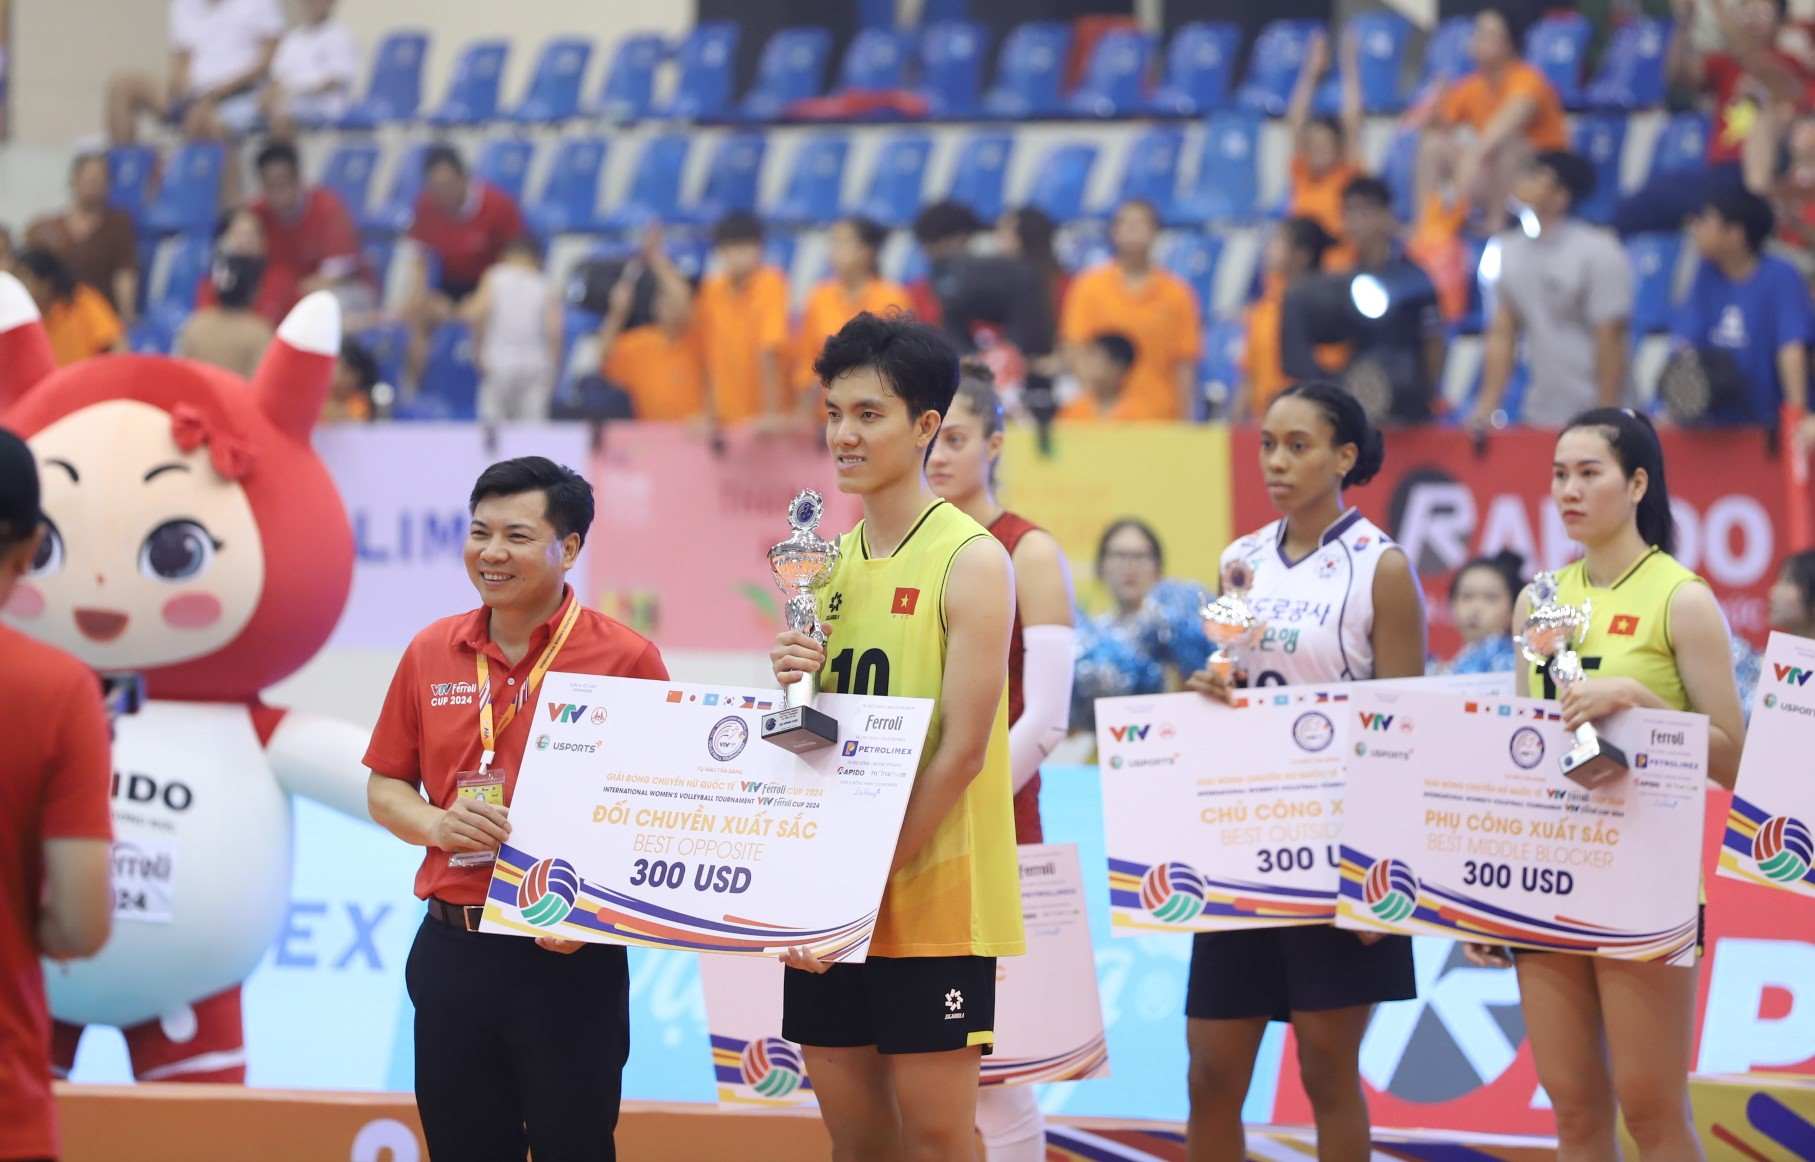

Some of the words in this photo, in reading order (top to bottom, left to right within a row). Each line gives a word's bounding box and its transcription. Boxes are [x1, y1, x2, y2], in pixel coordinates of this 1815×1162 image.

[830, 648, 890, 697] 10
[1774, 662, 1814, 687] VTV
[430, 683, 453, 696] VTV
[452, 682, 477, 695] Ferroli
[431, 697, 449, 706] CUP
[450, 695, 473, 705] 2024
[548, 702, 588, 724] VTV
[865, 713, 904, 733] Ferroli
[1359, 711, 1394, 731] VTV
[1110, 724, 1151, 742] VTV
[553, 742, 597, 754] USPORTS
[859, 746, 912, 756] PETROLIMEX
[603, 786, 648, 797] INTERNATIONAL
[649, 790, 679, 799] WOMEN'S
[679, 792, 714, 802] VOLLEYBALL
[714, 795, 755, 805] TOURNAMENT
[740, 780, 763, 793] VTV
[761, 782, 786, 795] Ferroli
[592, 800, 630, 825] ĐỐI
[719, 810, 773, 836] XUẤT
[776, 812, 817, 839] SẮC
[1254, 799, 1323, 821] CÔNG
[1467, 811, 1523, 836] CÔNG
[633, 833, 678, 854] BEST
[678, 837, 768, 861] OPPOSITE
[1257, 847, 1314, 873] 300
[630, 858, 686, 890] 300
[694, 863, 752, 894] USD
[1463, 860, 1512, 889] 300
[1522, 866, 1575, 895] USD
